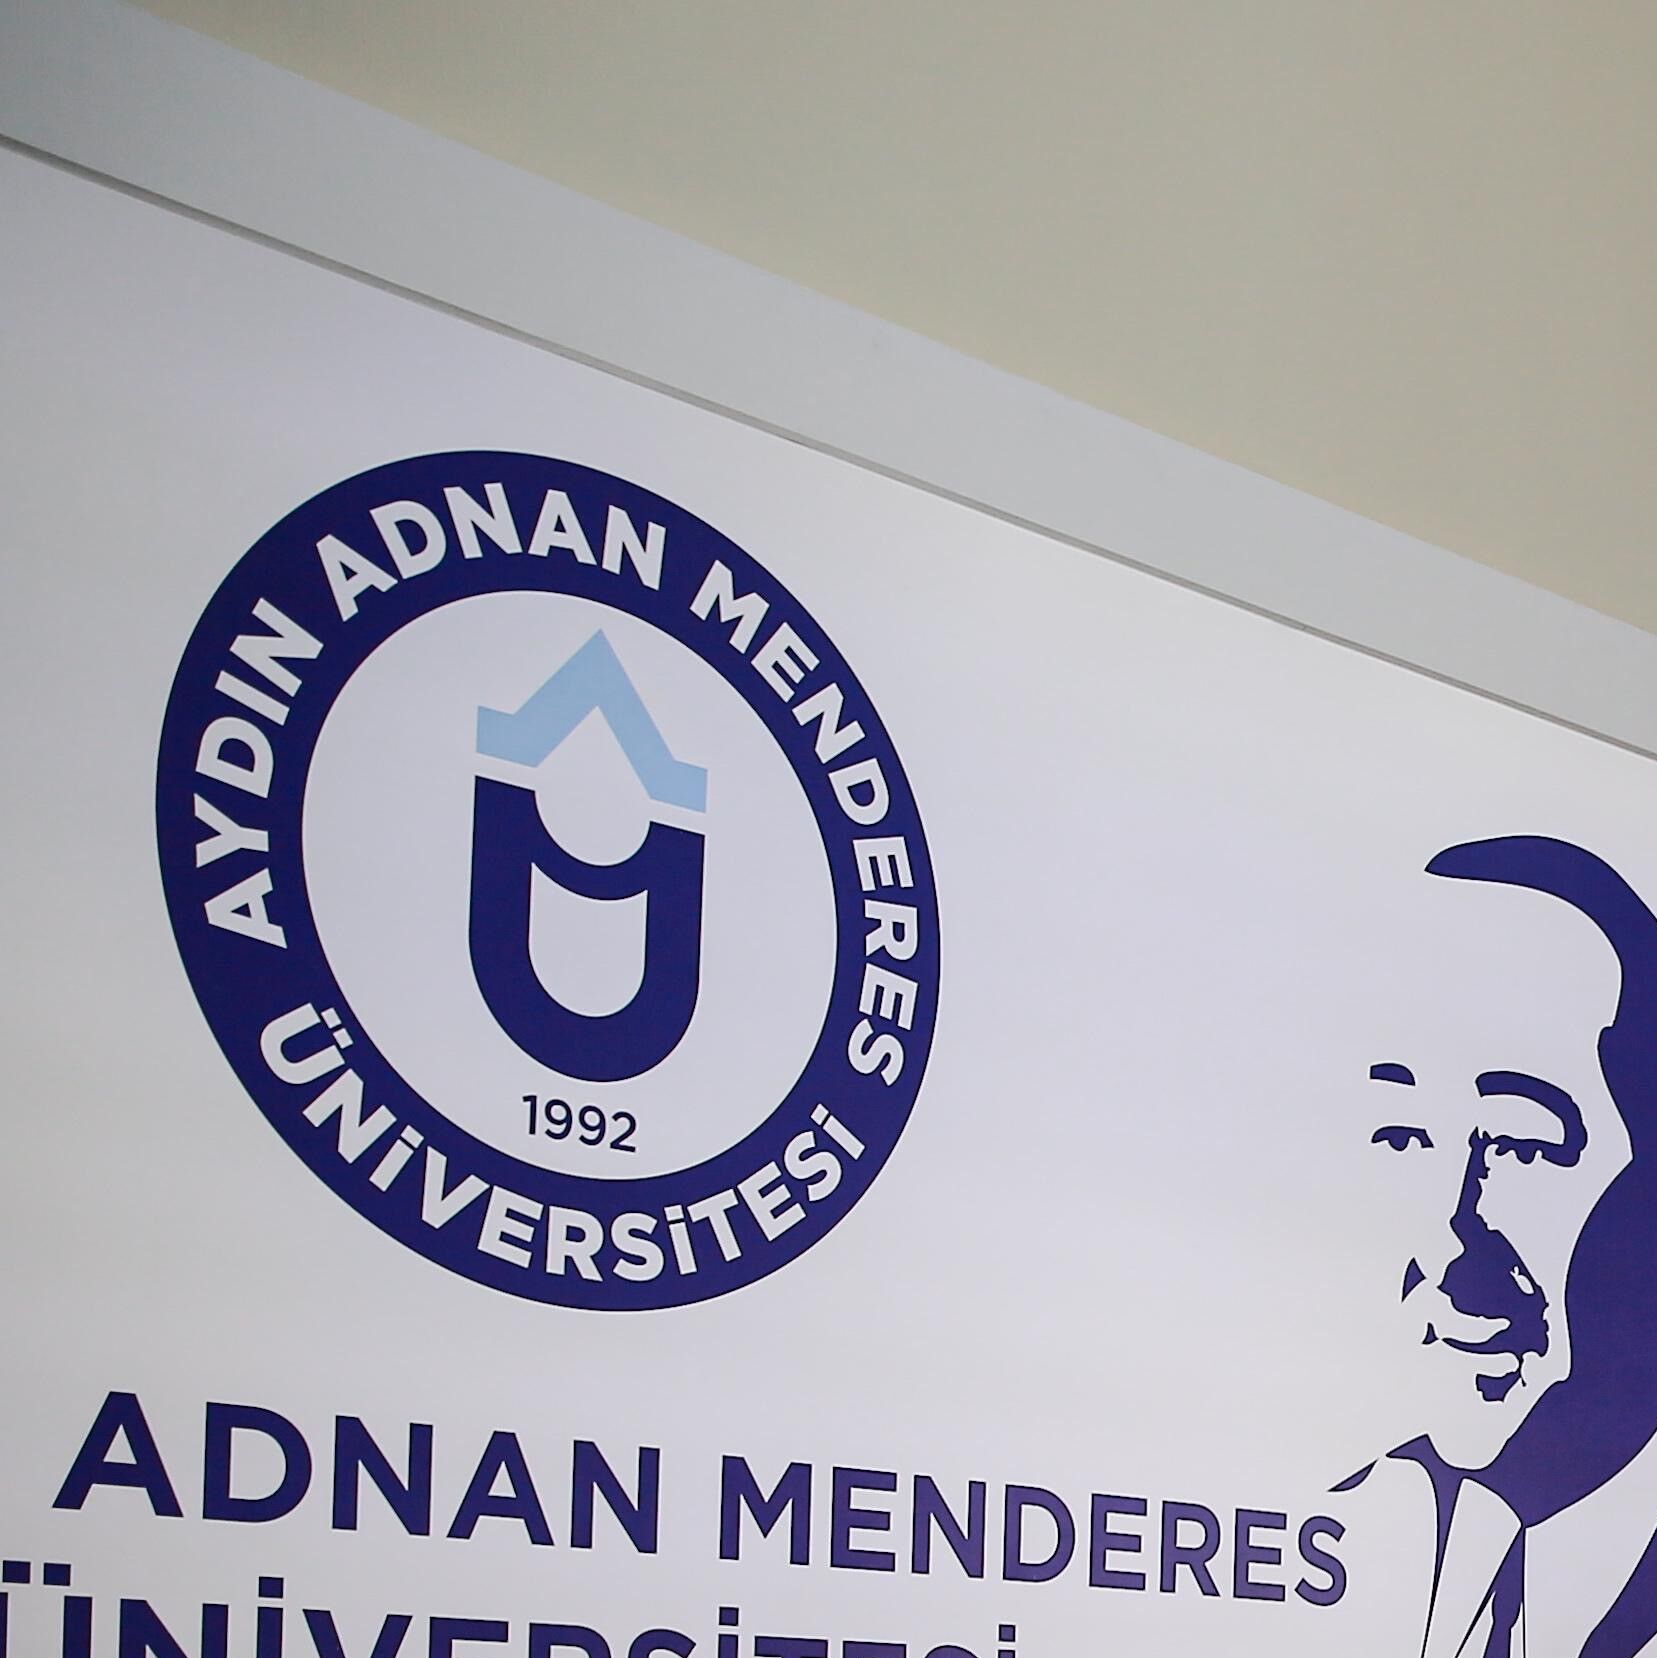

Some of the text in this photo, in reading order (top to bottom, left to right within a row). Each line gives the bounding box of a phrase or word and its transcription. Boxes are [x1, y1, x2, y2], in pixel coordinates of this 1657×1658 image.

[193, 482, 919, 1086] AYDIN ADNAN MENDERES
[260, 1002, 867, 1283] ÜNİVERSİTESİ
[522, 1094, 638, 1154] 1992
[51, 1390, 1348, 1608] ADNAN MENDERES
